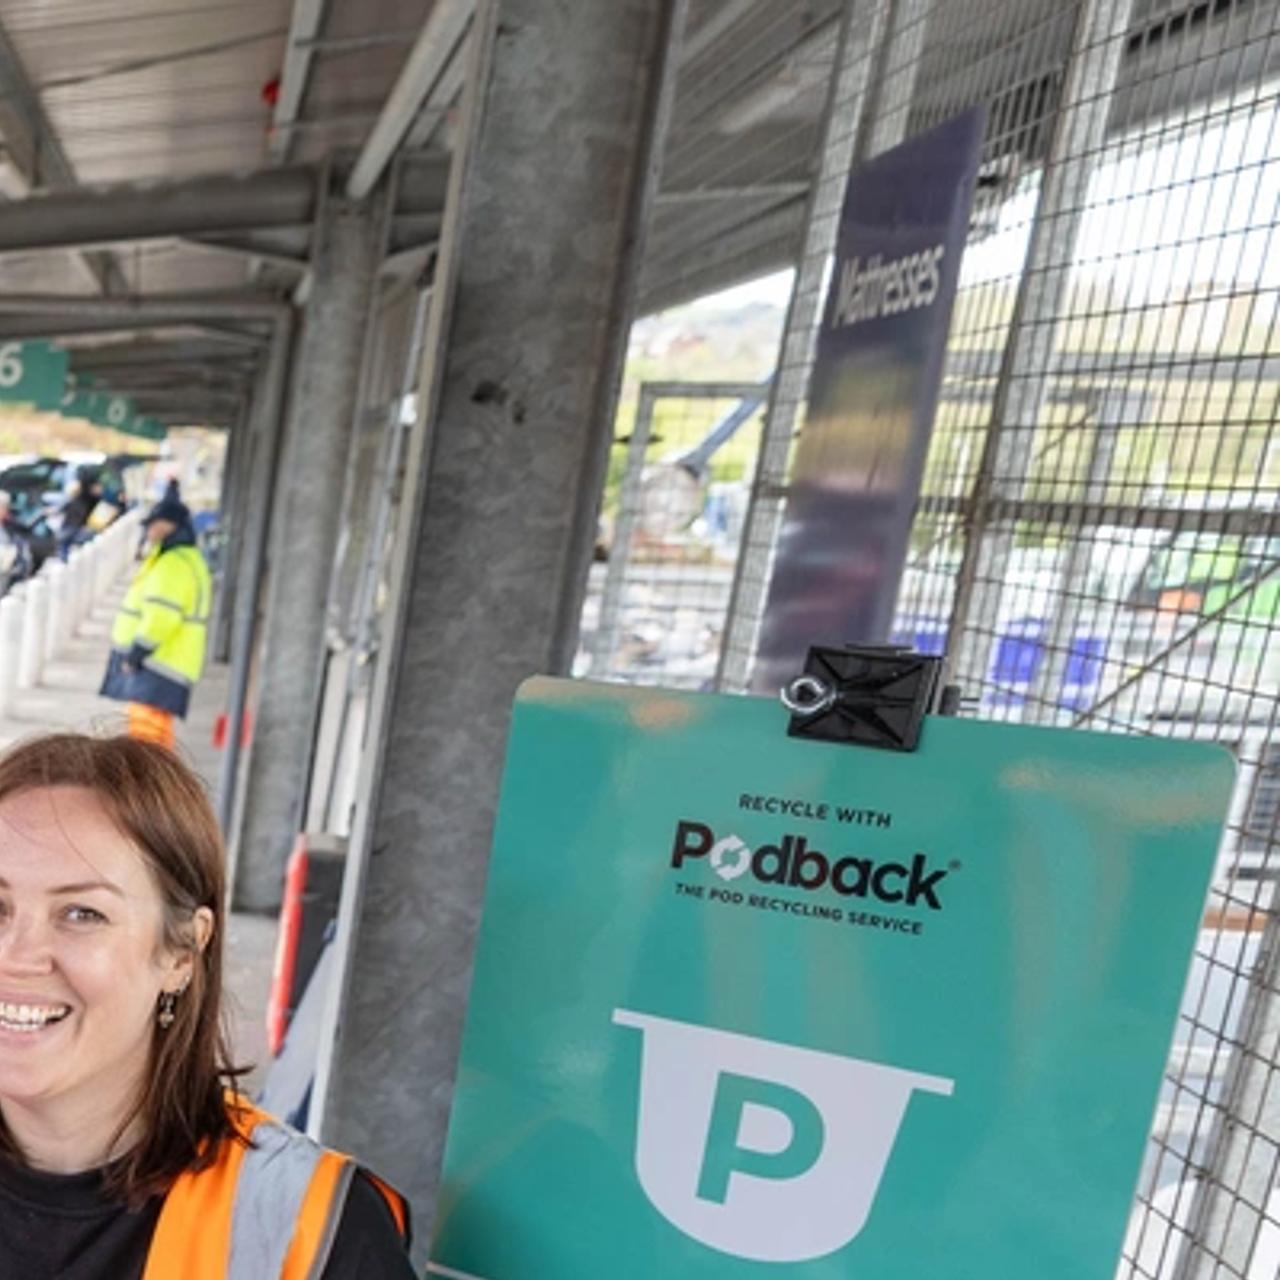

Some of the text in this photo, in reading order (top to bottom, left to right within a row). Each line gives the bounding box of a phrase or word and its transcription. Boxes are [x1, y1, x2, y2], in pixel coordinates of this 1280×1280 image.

[739, 793, 892, 829] RECYCLE WITH
[675, 882, 924, 935] THE POD RECYCLING SERVICE
[695, 1070, 826, 1206] P
